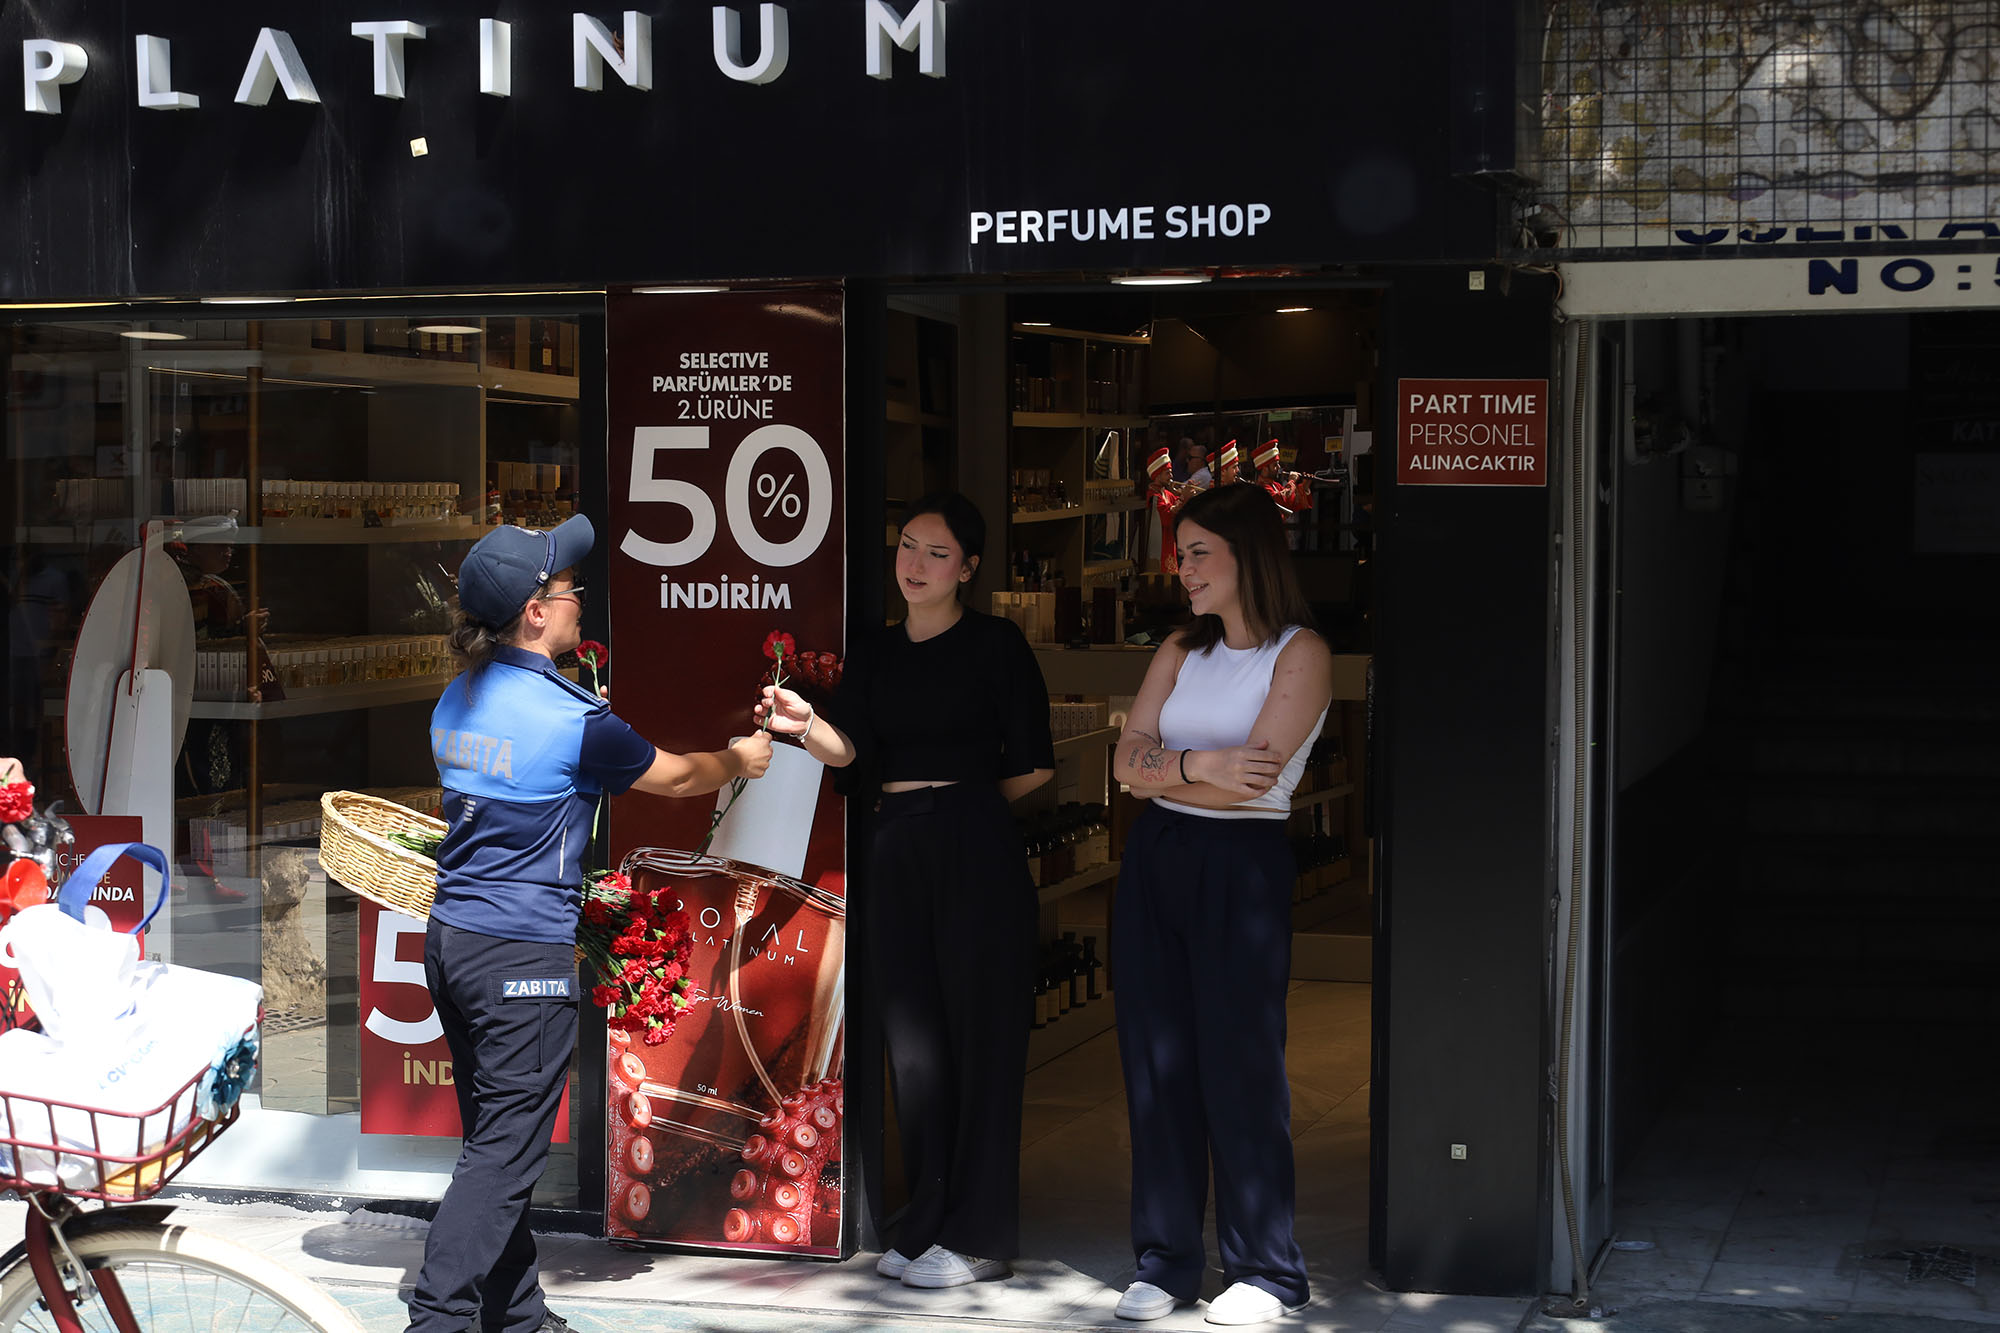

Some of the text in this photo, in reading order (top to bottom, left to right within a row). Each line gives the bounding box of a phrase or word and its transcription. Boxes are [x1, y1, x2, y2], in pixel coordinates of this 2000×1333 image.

[23, 0, 947, 114] PLATINUM
[970, 203, 1271, 245] PERFUME SHOP
[679, 352, 769, 369] SELECTIVE
[652, 371, 792, 393] PARFÜMLER'DE
[1409, 394, 1537, 415] PART TIME
[1410, 423, 1536, 446] PERSONEL
[1409, 454, 1535, 472] ALINACAKTIR
[619, 423, 833, 567] 50
[660, 573, 792, 610] İNDİRİM
[432, 728, 514, 780] ZABITA
[691, 931, 795, 966] LATINUM
[505, 980, 568, 996] ZABITA
[712, 995, 764, 1017] Women
[696, 1083, 719, 1096] 50 ml
